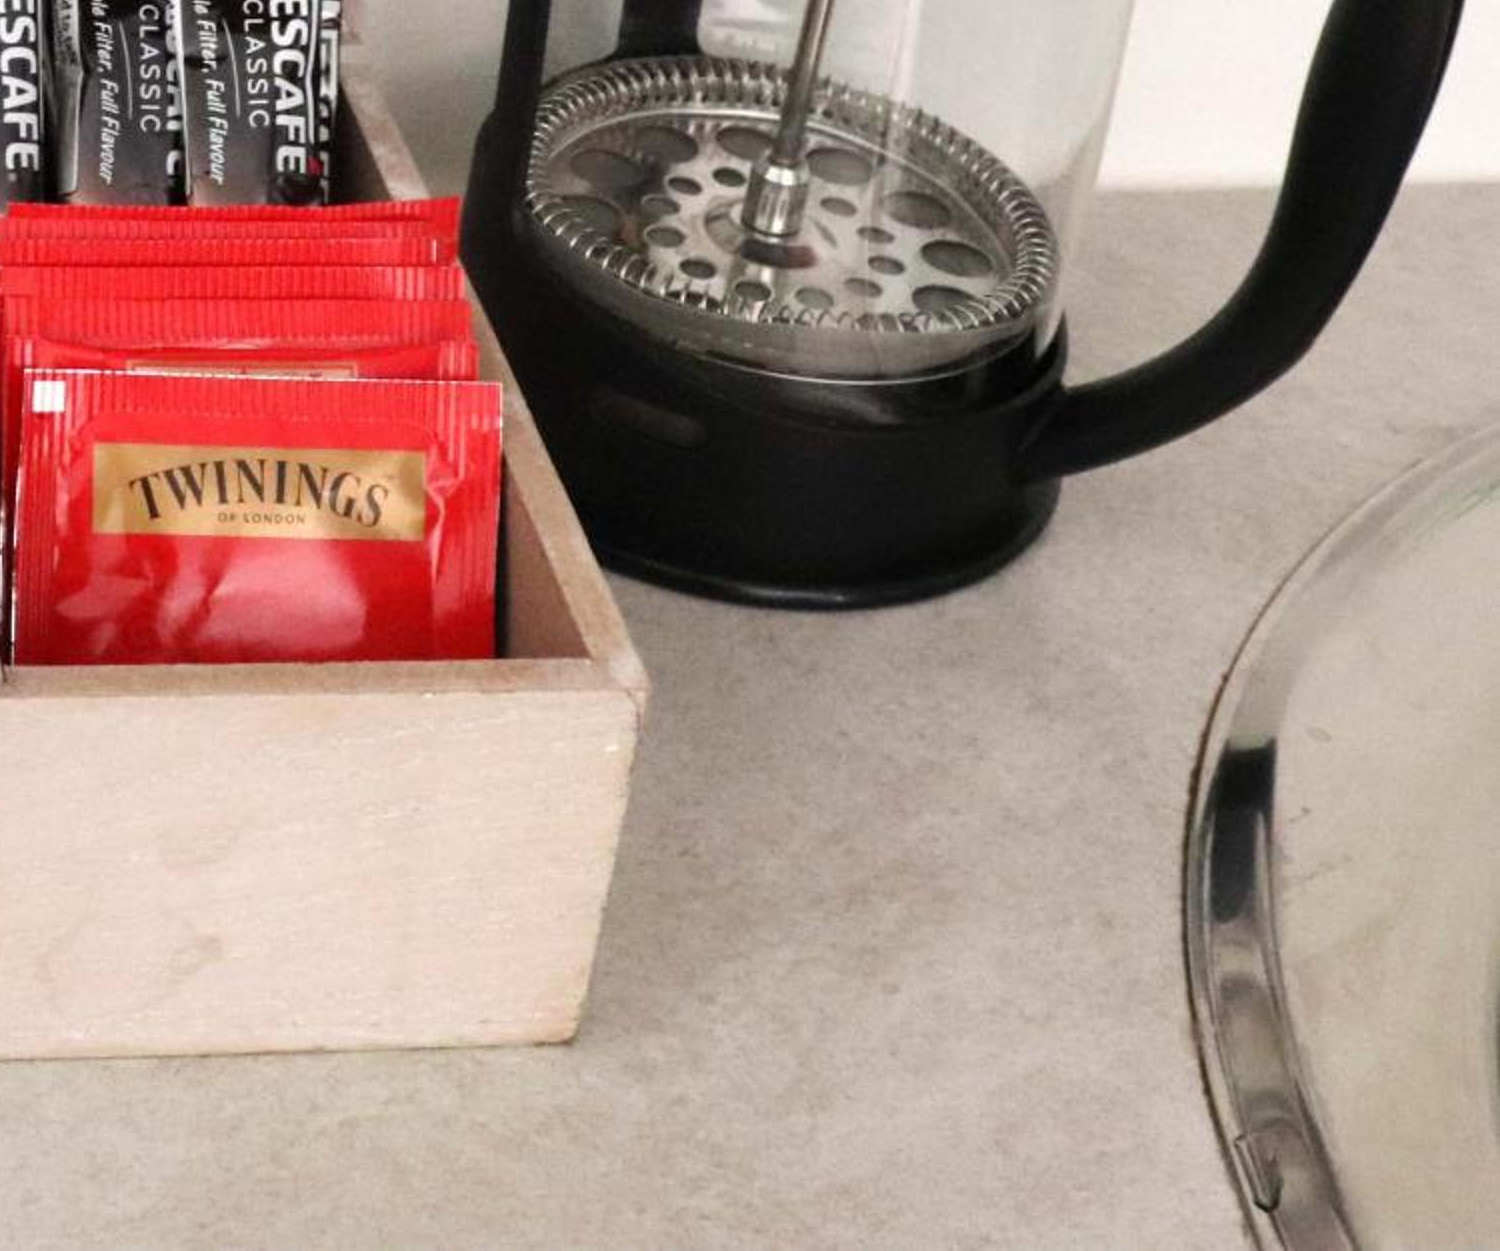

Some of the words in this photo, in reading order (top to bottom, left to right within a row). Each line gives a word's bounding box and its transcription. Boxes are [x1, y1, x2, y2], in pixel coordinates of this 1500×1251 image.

[100, 79, 119, 122] Full
[139, 4, 161, 132] CLASSIC
[206, 79, 226, 121] Full
[100, 119, 121, 185] Flavour
[208, 120, 229, 186] Flavour
[128, 458, 389, 528] TWININGS
[218, 511, 238, 525] OF
[243, 512, 308, 527] LONDON
